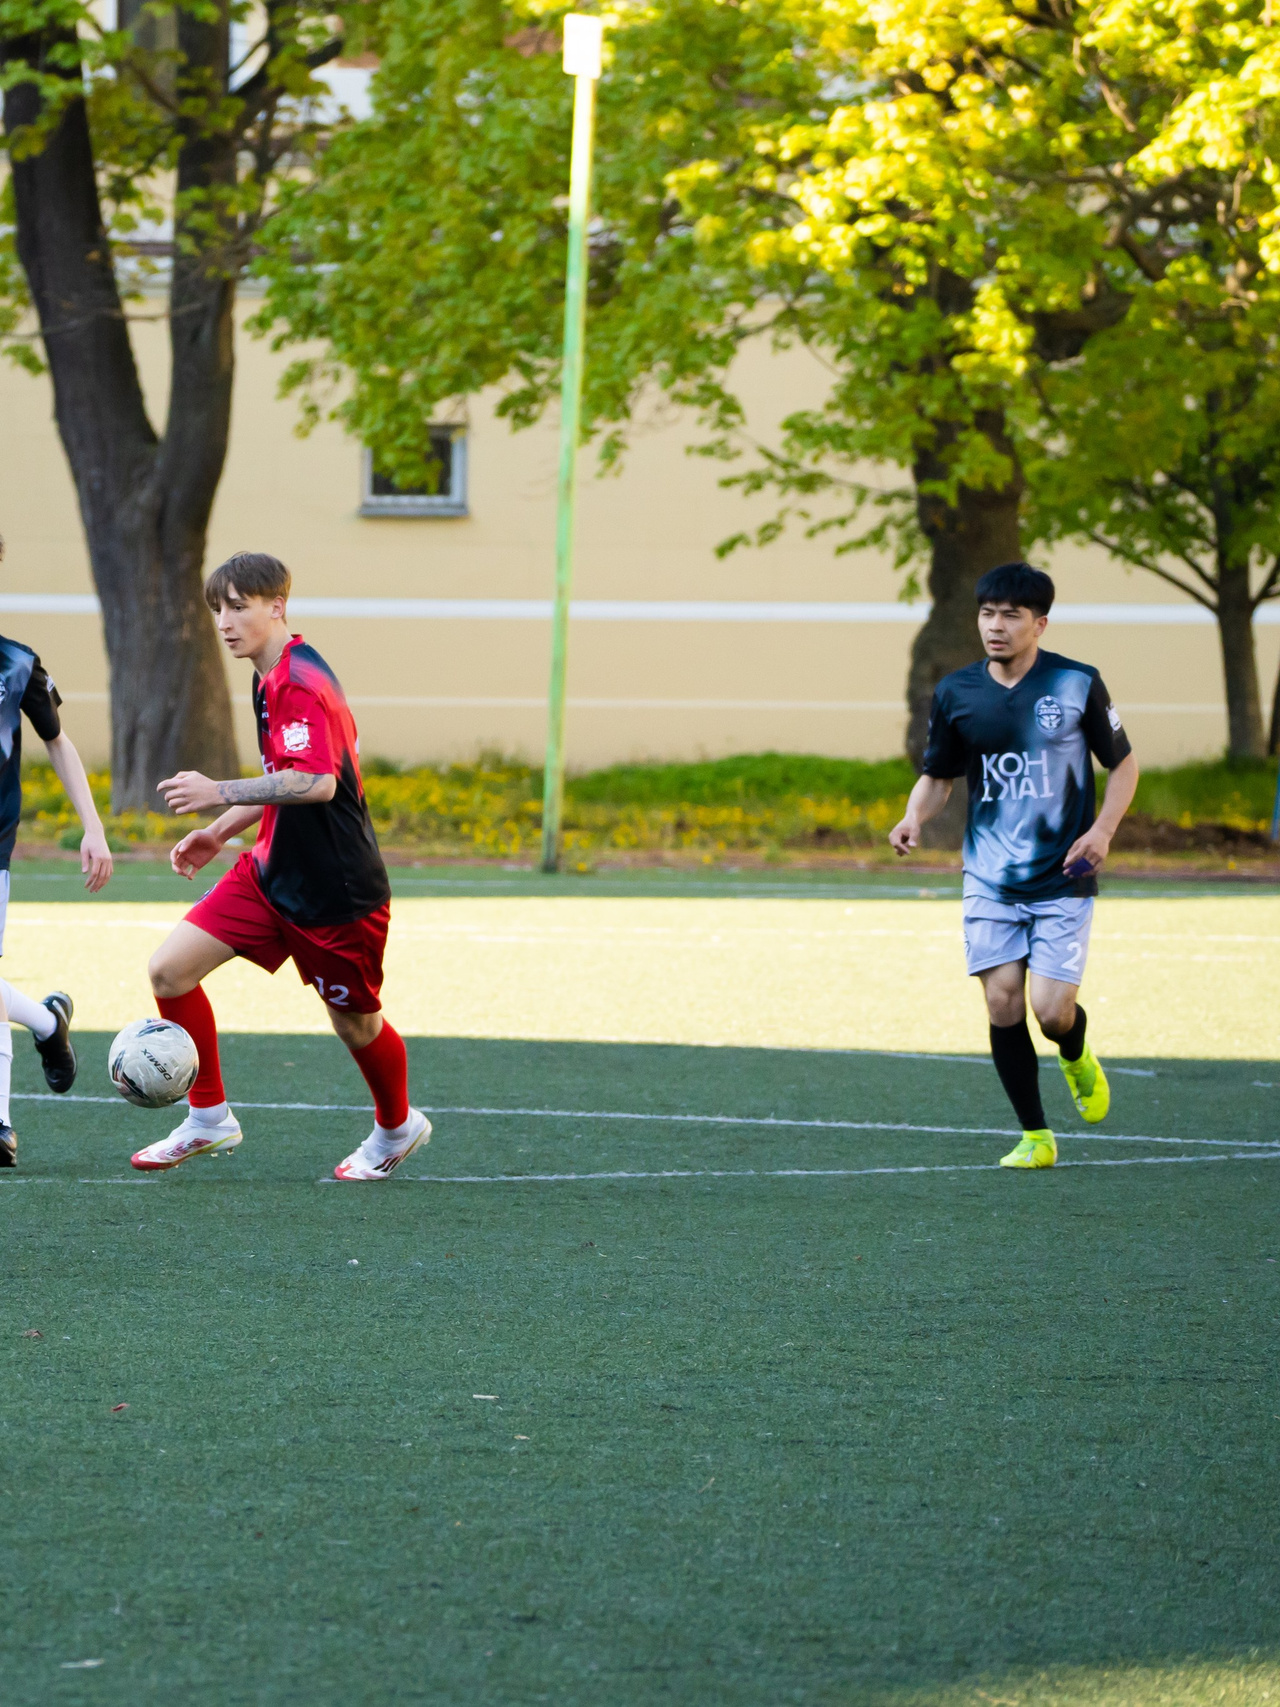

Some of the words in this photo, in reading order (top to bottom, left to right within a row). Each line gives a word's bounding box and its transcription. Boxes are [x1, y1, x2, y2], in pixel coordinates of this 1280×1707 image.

[1060, 941, 1083, 972] 2
[314, 975, 350, 1006] 12
[141, 1048, 173, 1081] DEMIX
